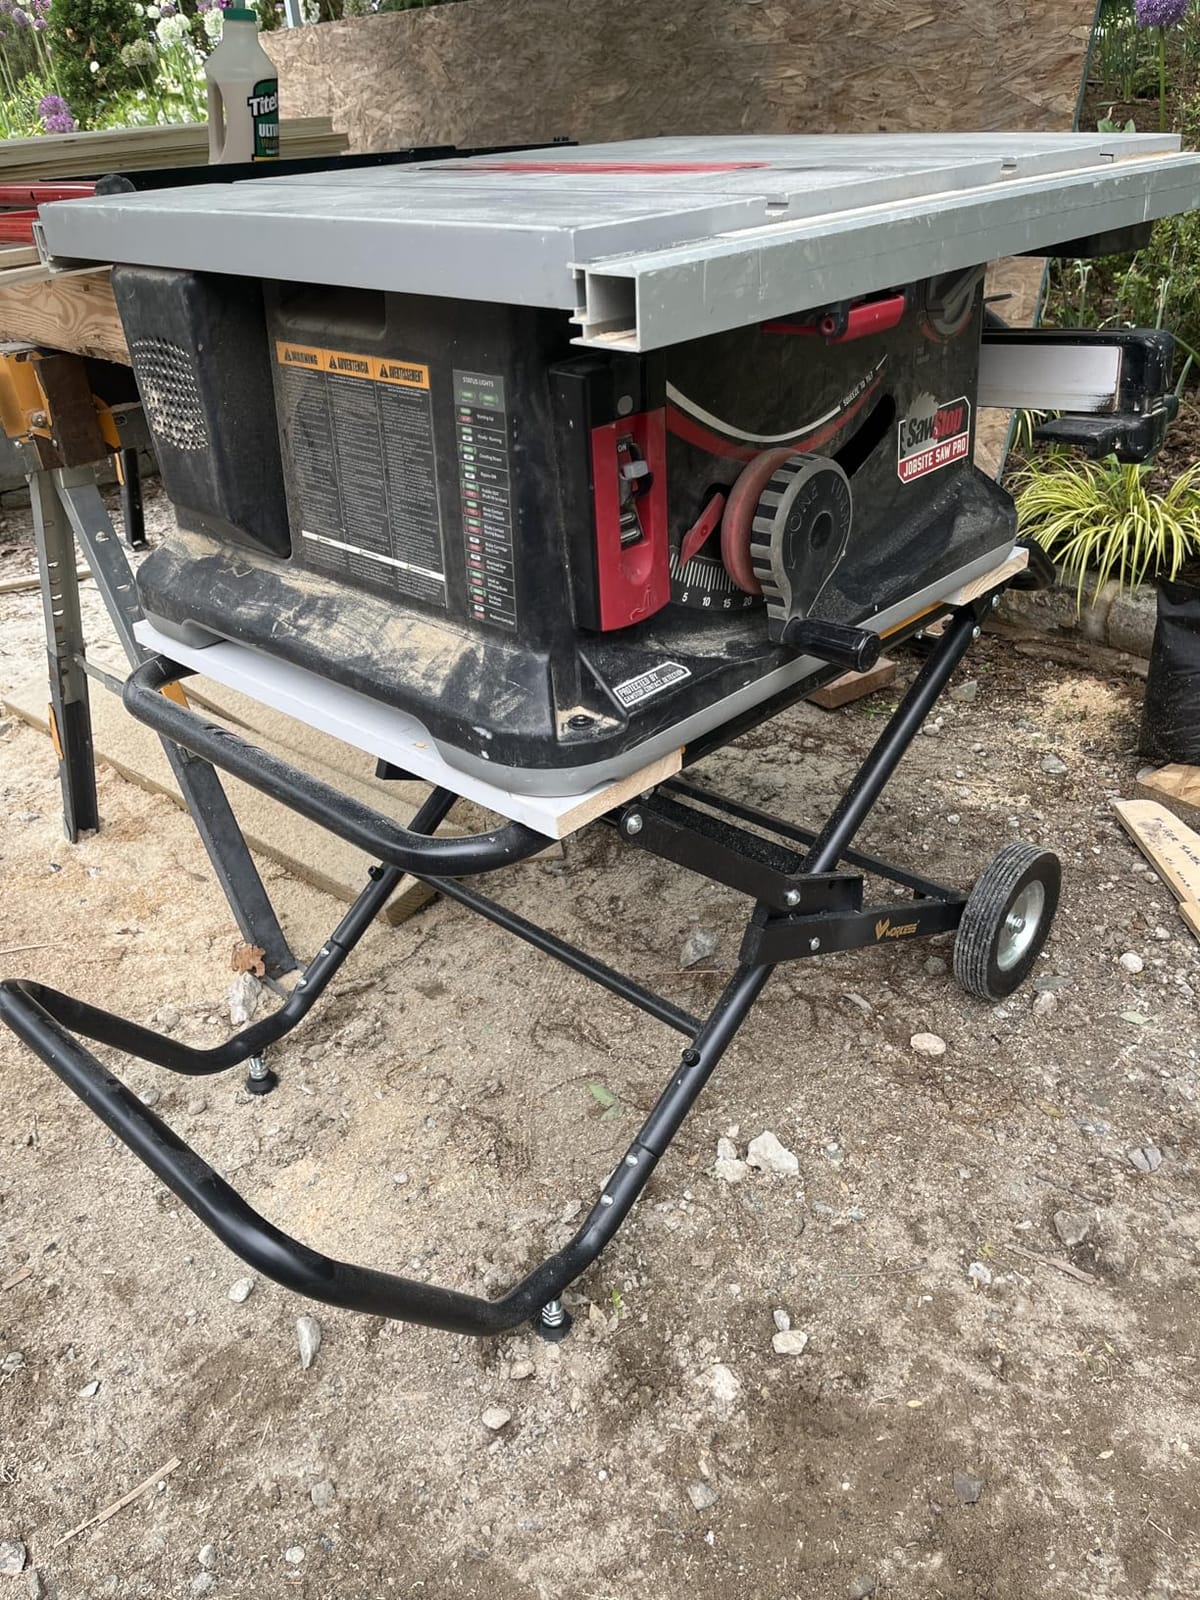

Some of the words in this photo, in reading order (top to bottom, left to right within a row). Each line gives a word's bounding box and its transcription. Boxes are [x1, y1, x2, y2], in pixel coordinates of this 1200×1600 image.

[292, 350, 318, 365] WARNING
[462, 376, 479, 385] STATUS
[479, 379, 495, 388] LIGHTS
[843, 386, 860, 407] SQUEEZE
[905, 405, 964, 448] SawStop
[617, 443, 628, 452] ON
[903, 452, 934, 478] JOBSITE
[935, 444, 951, 463] SAW
[952, 437, 966, 456] PRO
[681, 592, 689, 602] 5
[702, 597, 711, 607] 10
[723, 599, 732, 608] 15
[743, 596, 752, 607] 20
[618, 677, 651, 698] PROTECTED
[649, 672, 659, 682] BY
[623, 688, 645, 702] SAWSTOP
[643, 680, 662, 692] CONTACT
[661, 669, 685, 683] DETECTION
